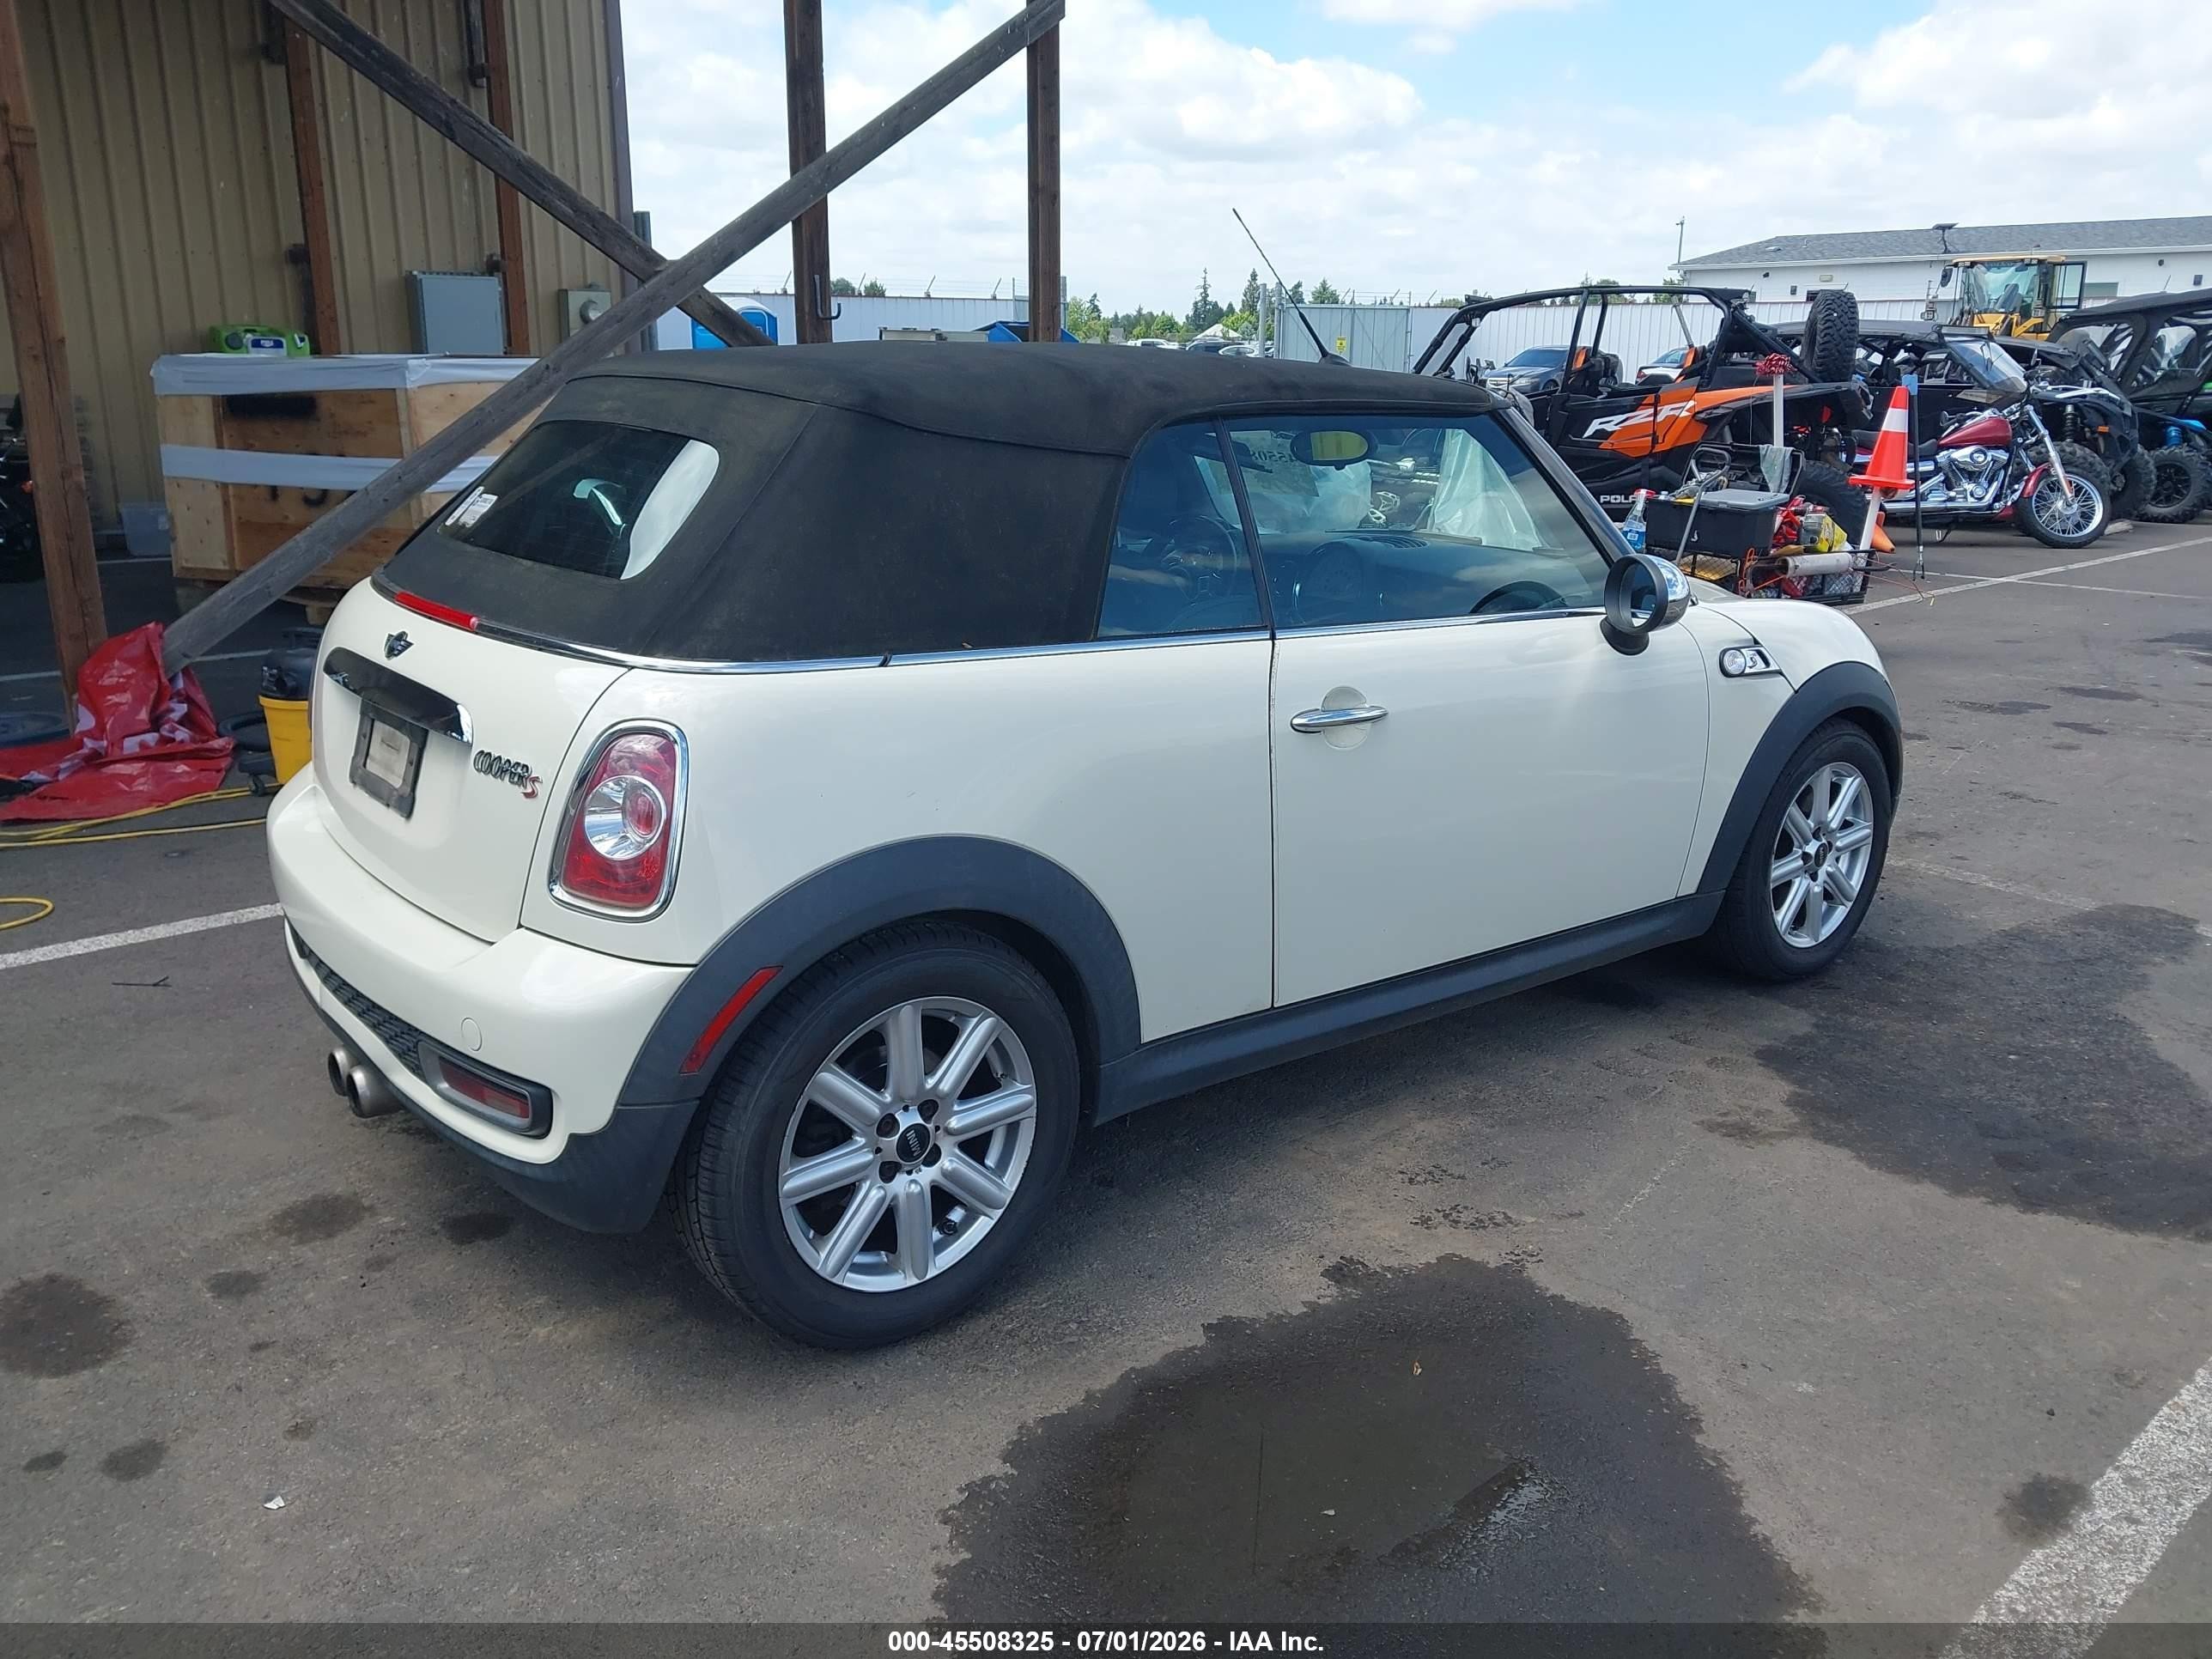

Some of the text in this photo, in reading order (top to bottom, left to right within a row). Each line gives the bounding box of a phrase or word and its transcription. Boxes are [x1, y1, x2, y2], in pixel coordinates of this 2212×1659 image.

[1583, 399, 1697, 439] RZR
[473, 750, 543, 799] COOPER S
[906, 1129, 921, 1157] MINI
